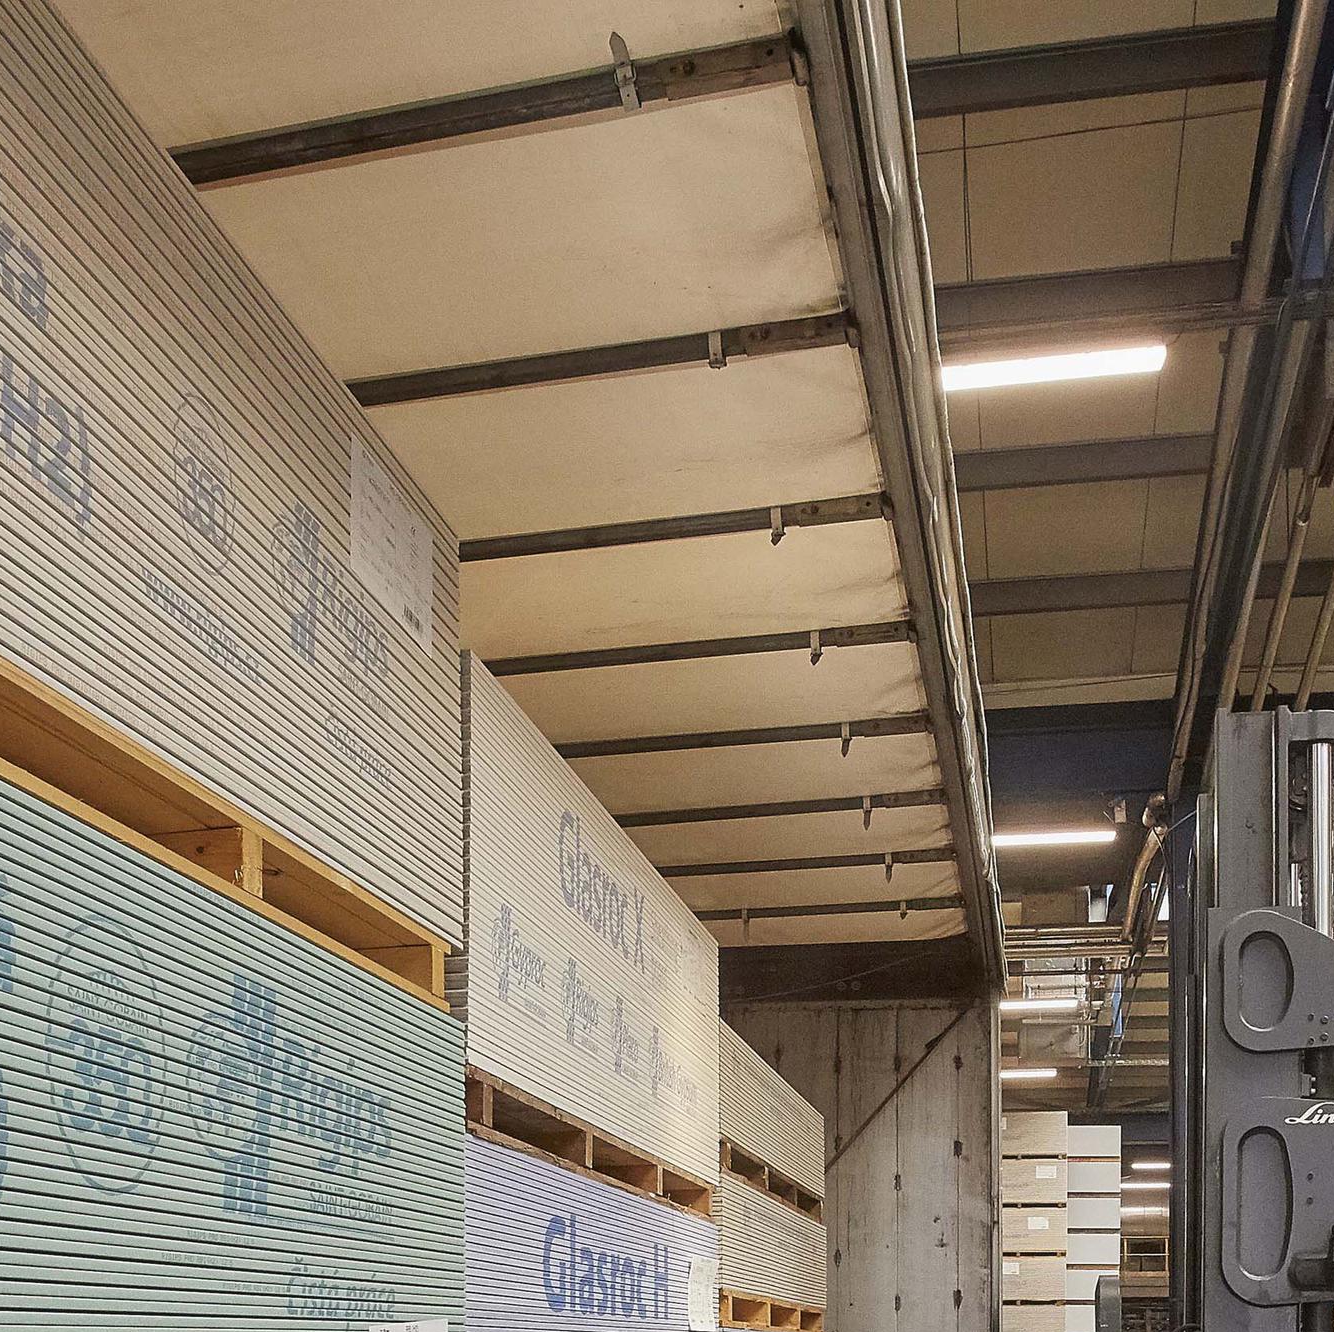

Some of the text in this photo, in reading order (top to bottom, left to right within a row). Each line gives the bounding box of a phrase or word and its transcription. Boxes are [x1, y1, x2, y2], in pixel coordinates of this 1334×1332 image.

[320, 554, 389, 678] Rigips
[559, 810, 628, 960] Glasroc
[633, 886, 646, 975] X
[278, 1037, 393, 1177] Rigips
[542, 1214, 647, 1320] Glasroc
[653, 1243, 668, 1320] H
